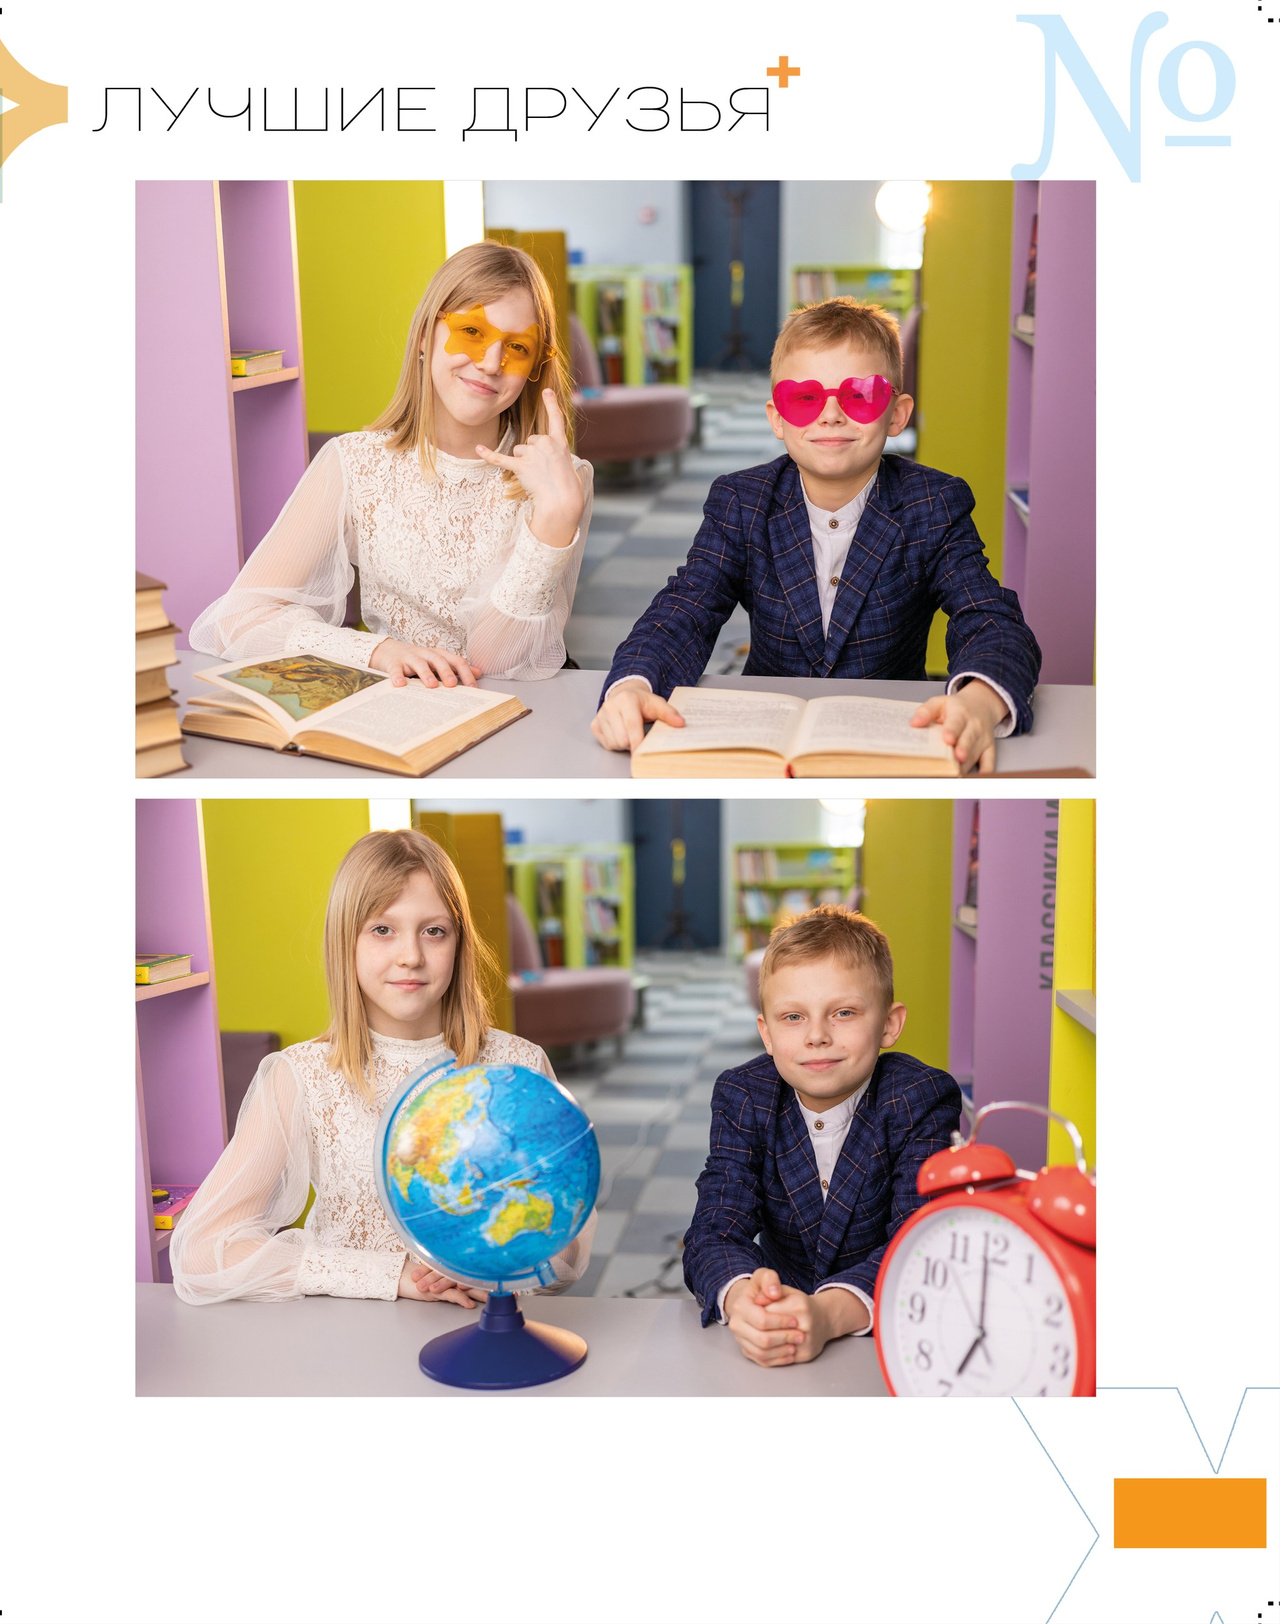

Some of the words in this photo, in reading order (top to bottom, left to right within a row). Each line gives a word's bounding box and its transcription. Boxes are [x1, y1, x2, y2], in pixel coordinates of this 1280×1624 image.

[949, 1231, 970, 1264] 11
[922, 1256, 948, 1290] 10
[1024, 1252, 1036, 1285] 1
[909, 1293, 926, 1323] 9
[1044, 1296, 1063, 1328] 2
[915, 1340, 932, 1371] 8
[1050, 1344, 1069, 1379] 3
